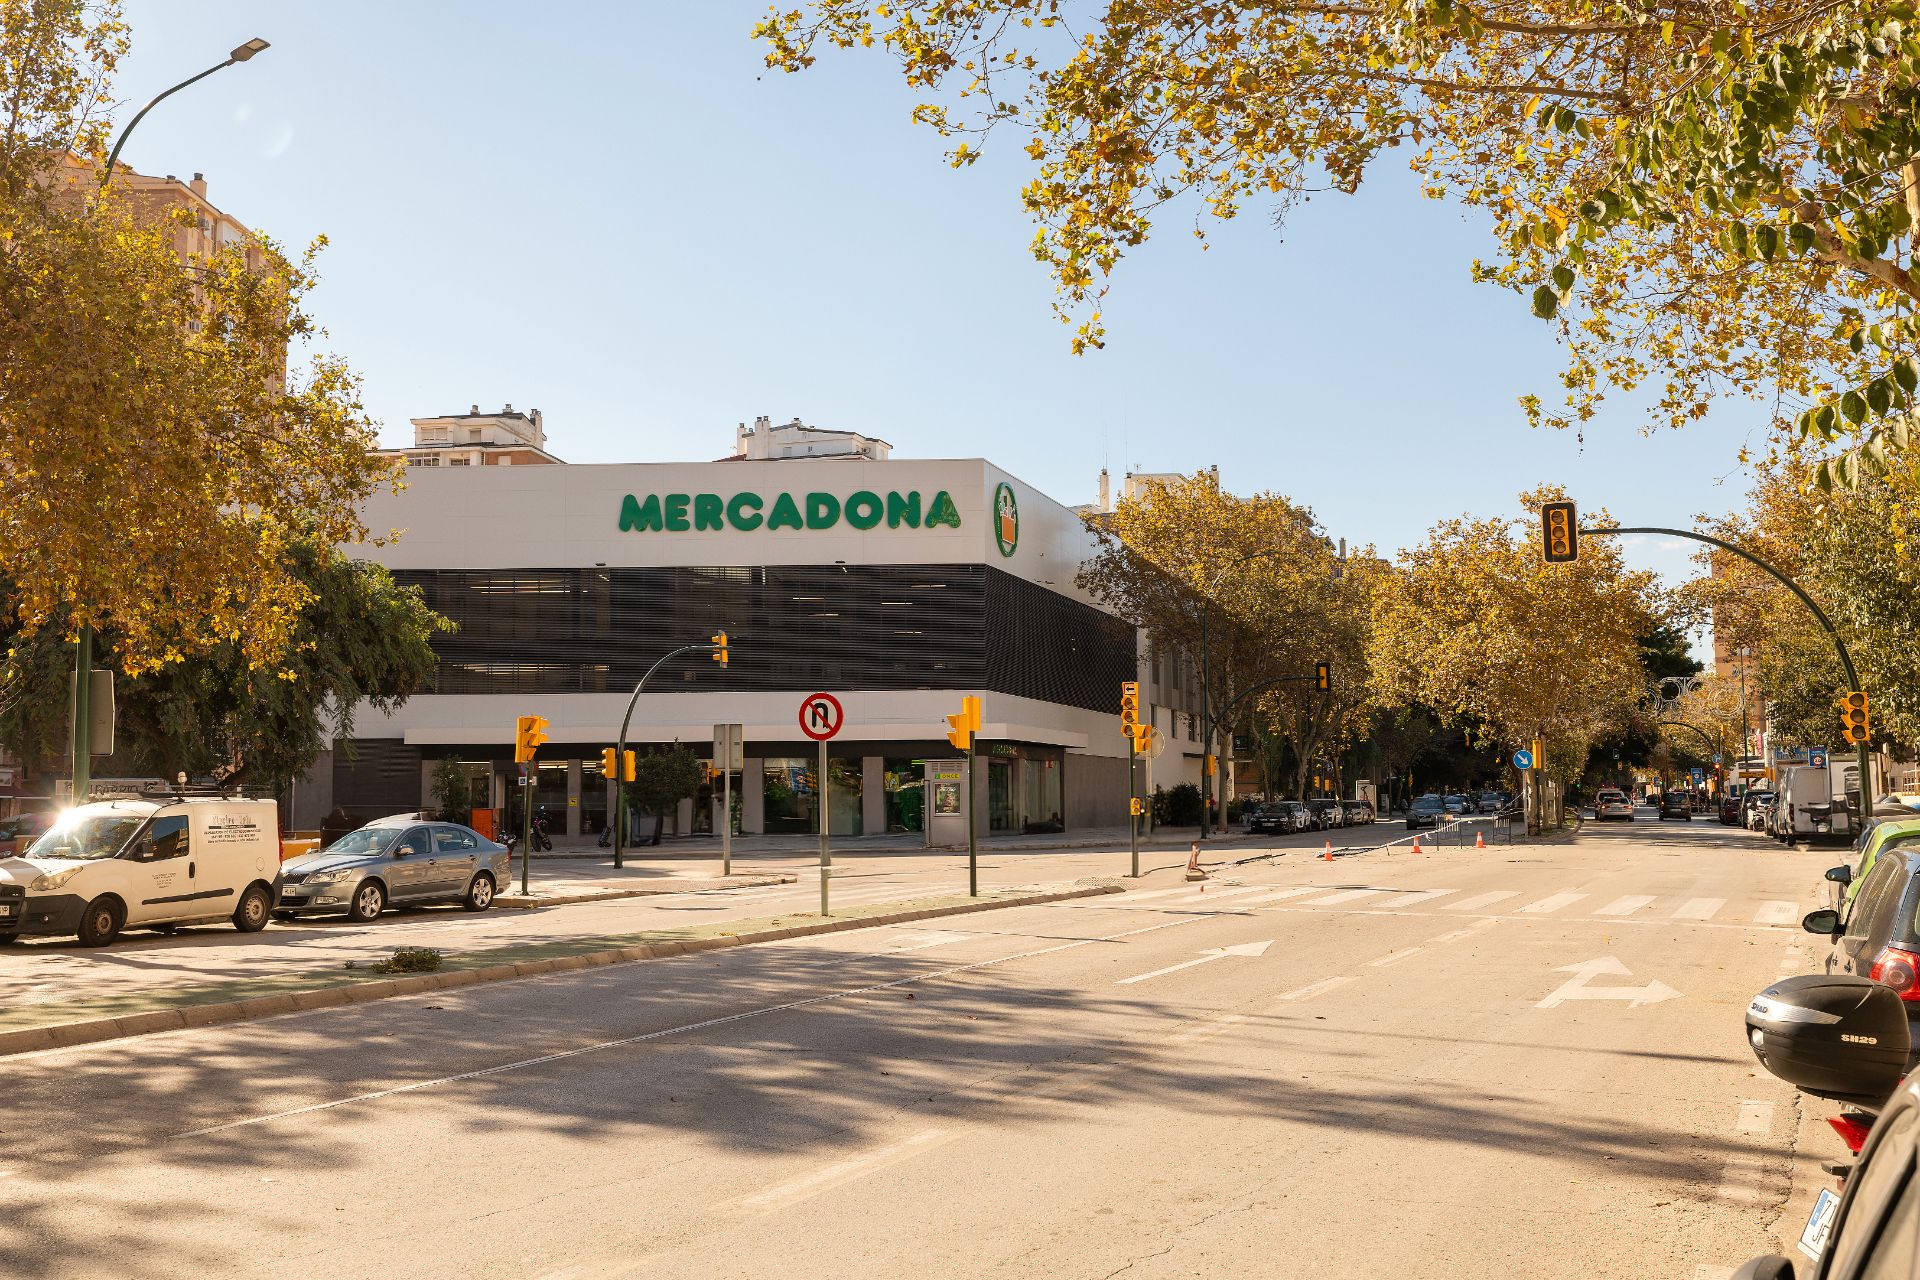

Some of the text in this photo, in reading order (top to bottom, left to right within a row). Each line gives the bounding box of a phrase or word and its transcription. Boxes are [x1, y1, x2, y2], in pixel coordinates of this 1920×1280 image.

[618, 490, 962, 532] MERCADONA
[1751, 1002, 1769, 1014] SHAD
[1840, 1034, 1878, 1045] SH29
[1820, 1200, 1838, 1224] 71
[1812, 1224, 1831, 1245] JF
